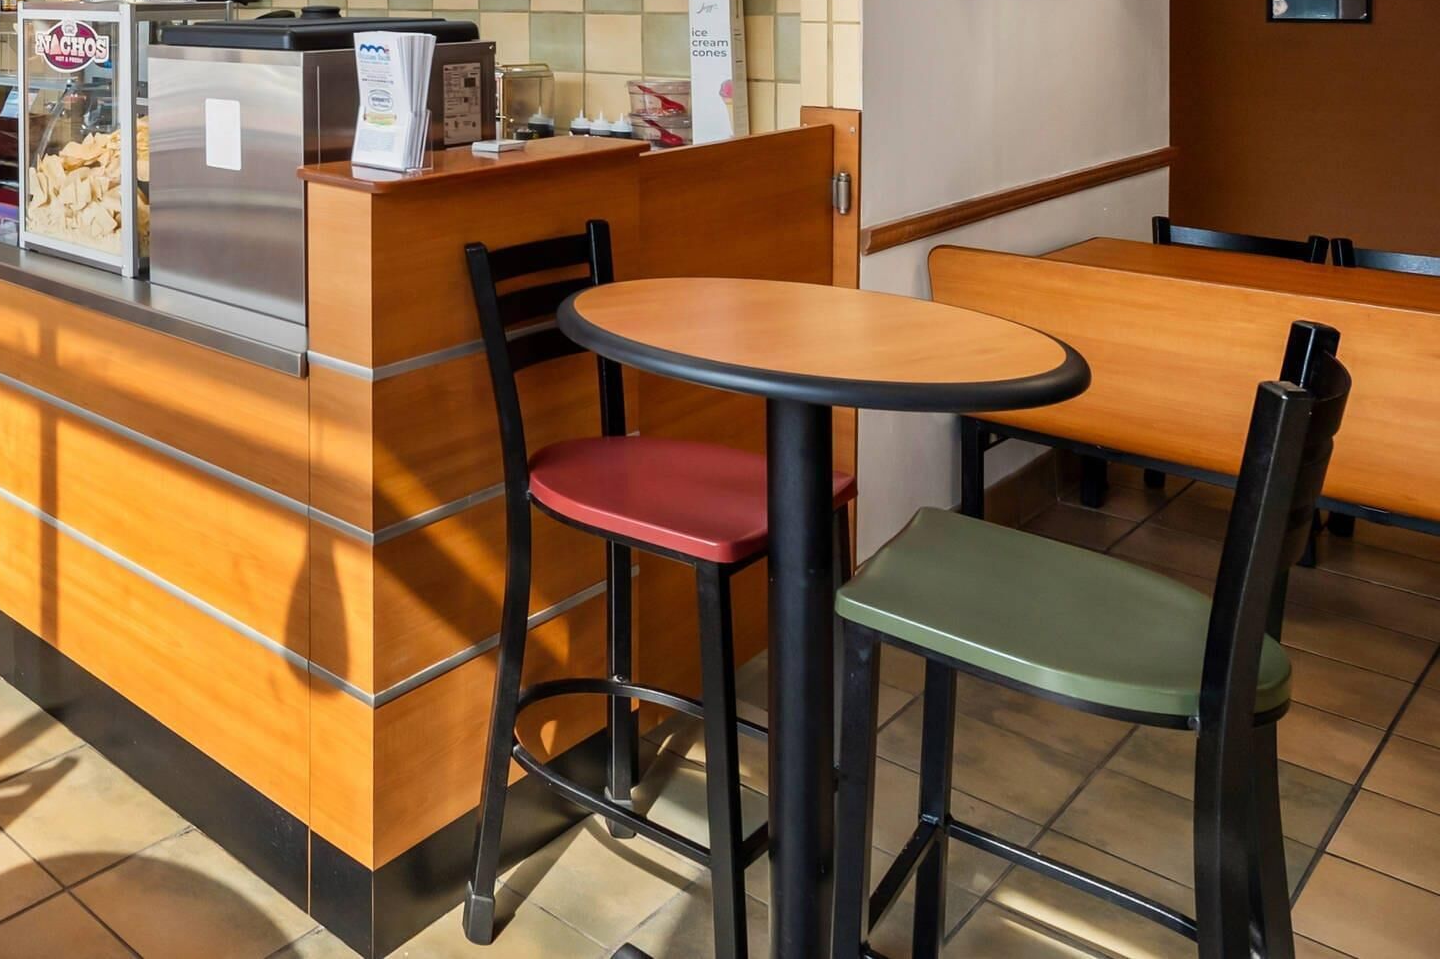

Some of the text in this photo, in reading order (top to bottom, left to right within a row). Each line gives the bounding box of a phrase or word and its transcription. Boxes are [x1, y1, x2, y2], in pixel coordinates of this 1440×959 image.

[691, 26, 708, 37] ice
[36, 32, 108, 59] NACHOS
[691, 39, 729, 47] cream
[692, 49, 728, 58] cones
